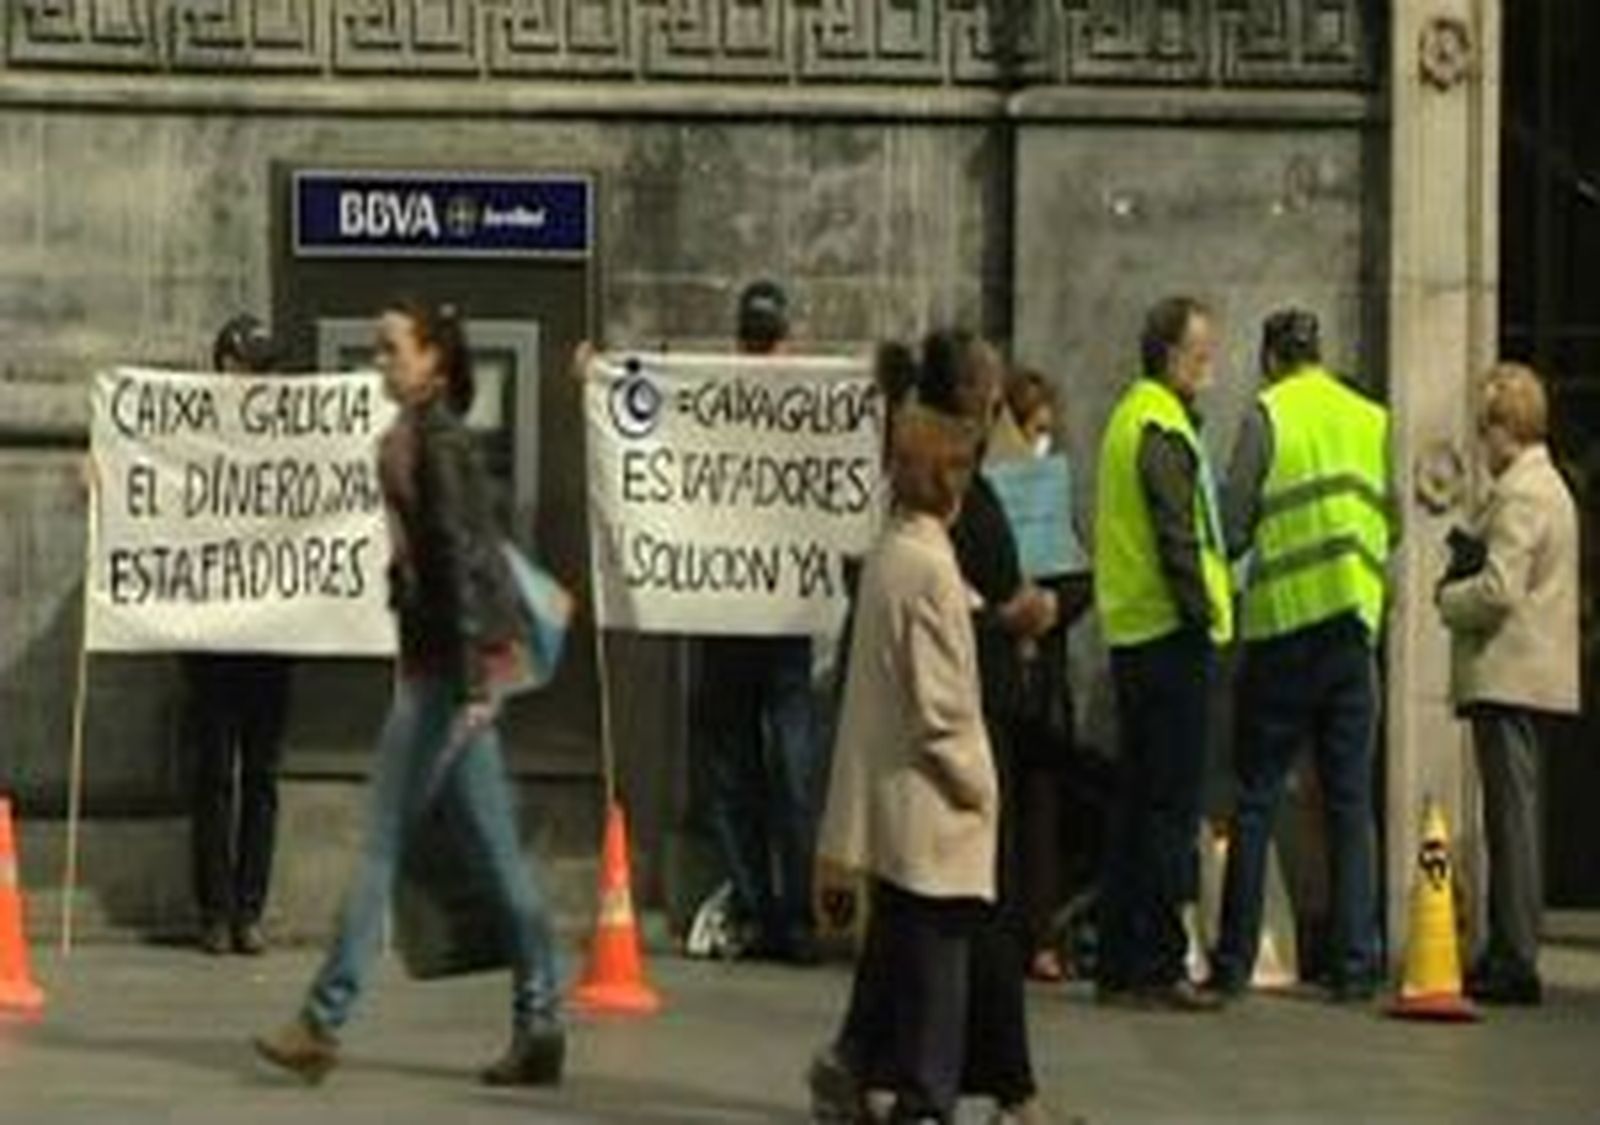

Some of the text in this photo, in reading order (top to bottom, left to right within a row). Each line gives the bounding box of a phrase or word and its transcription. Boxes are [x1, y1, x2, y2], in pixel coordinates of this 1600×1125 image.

[339, 190, 440, 239] BBVA
[111, 378, 371, 438] CAIXA GALICIA
[127, 465, 158, 517] EL
[622, 448, 870, 514] ESTAFADORES
[110, 537, 369, 605] ESTAFADORES
